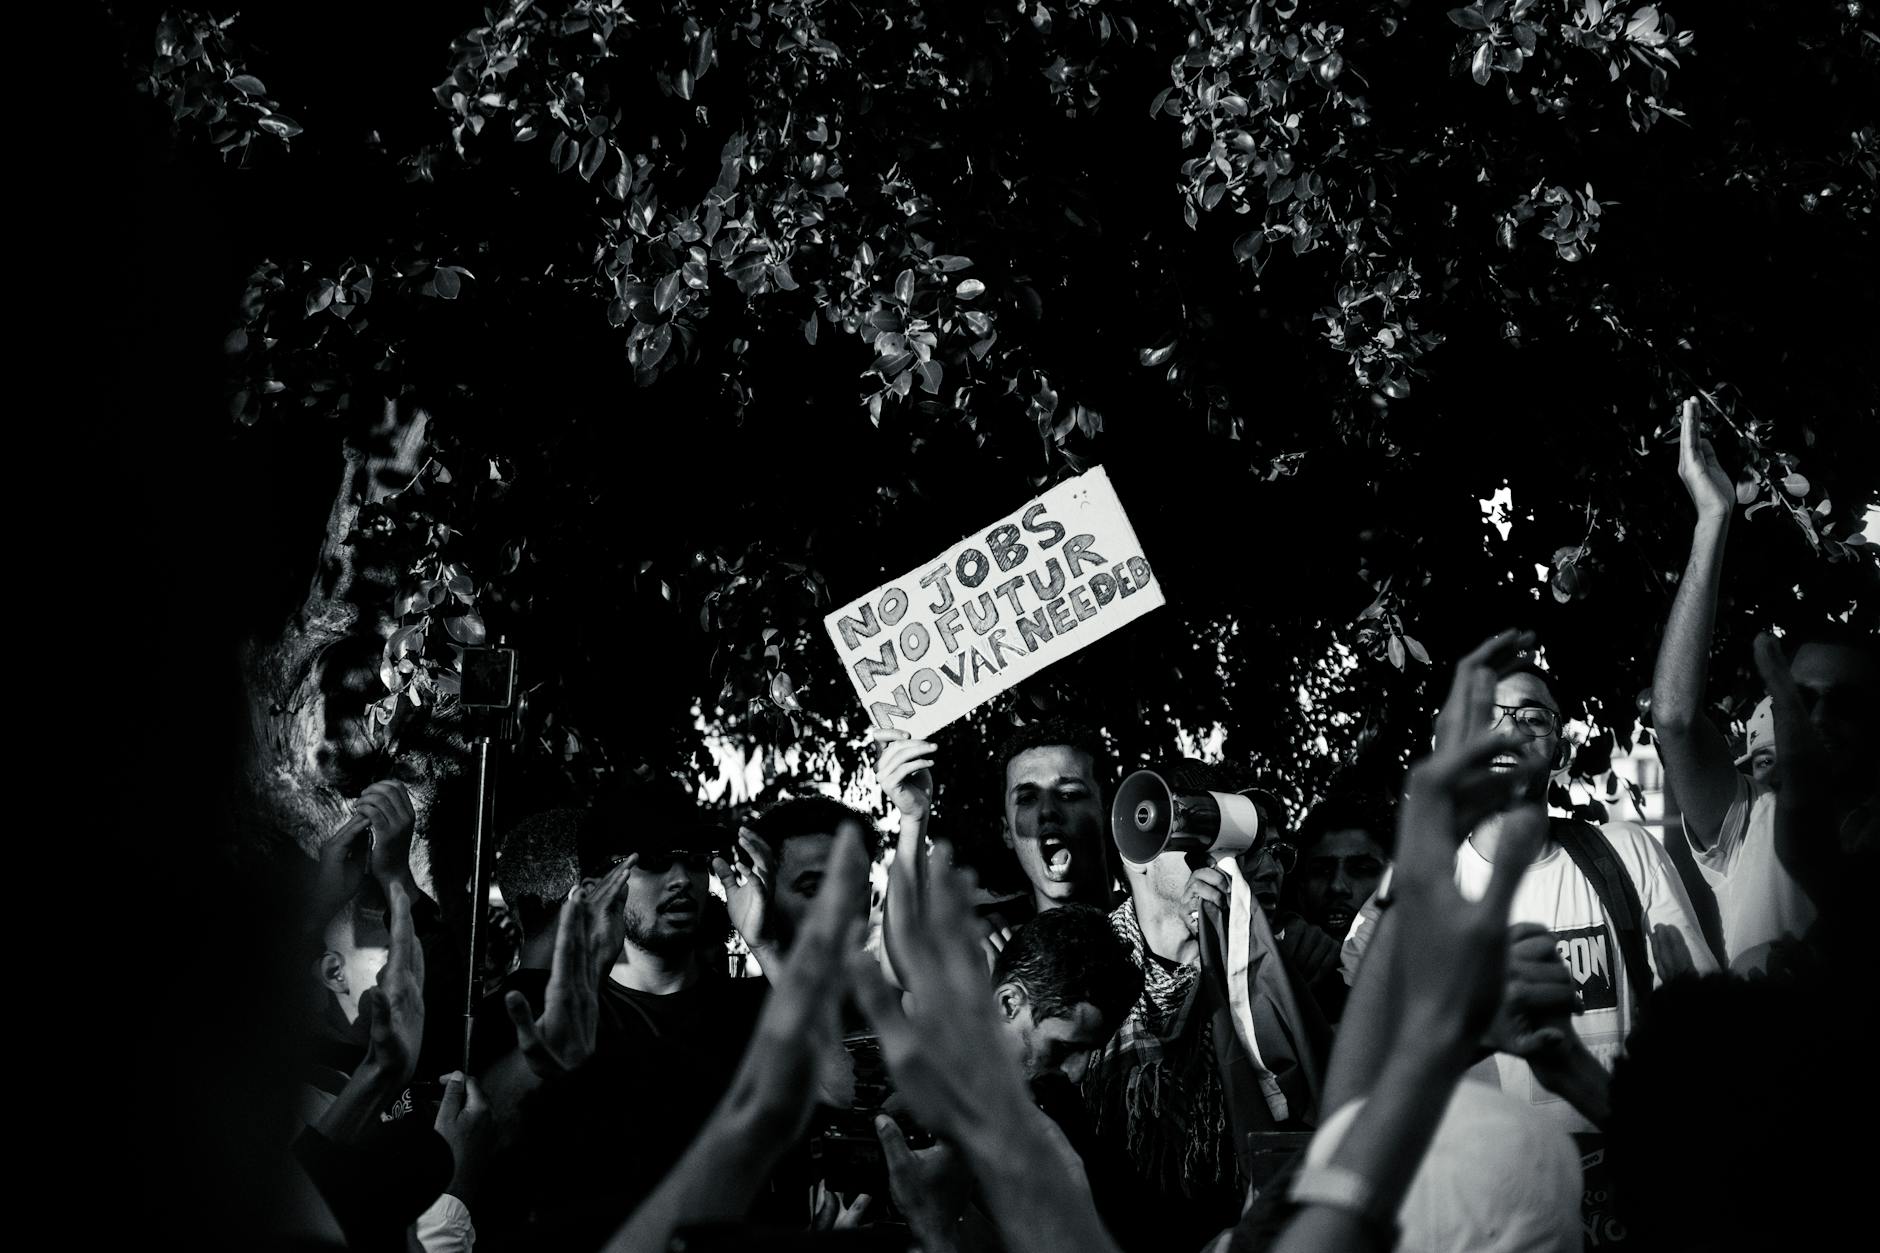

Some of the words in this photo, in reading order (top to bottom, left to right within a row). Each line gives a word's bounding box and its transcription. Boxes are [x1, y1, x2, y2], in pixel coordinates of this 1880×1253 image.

[837, 587, 909, 651] NO
[919, 503, 1066, 614] JOBS
[853, 621, 930, 692] NO
[934, 533, 1108, 654] FUTUR
[869, 667, 944, 730] NO
[1016, 555, 1151, 653] NEEDED
